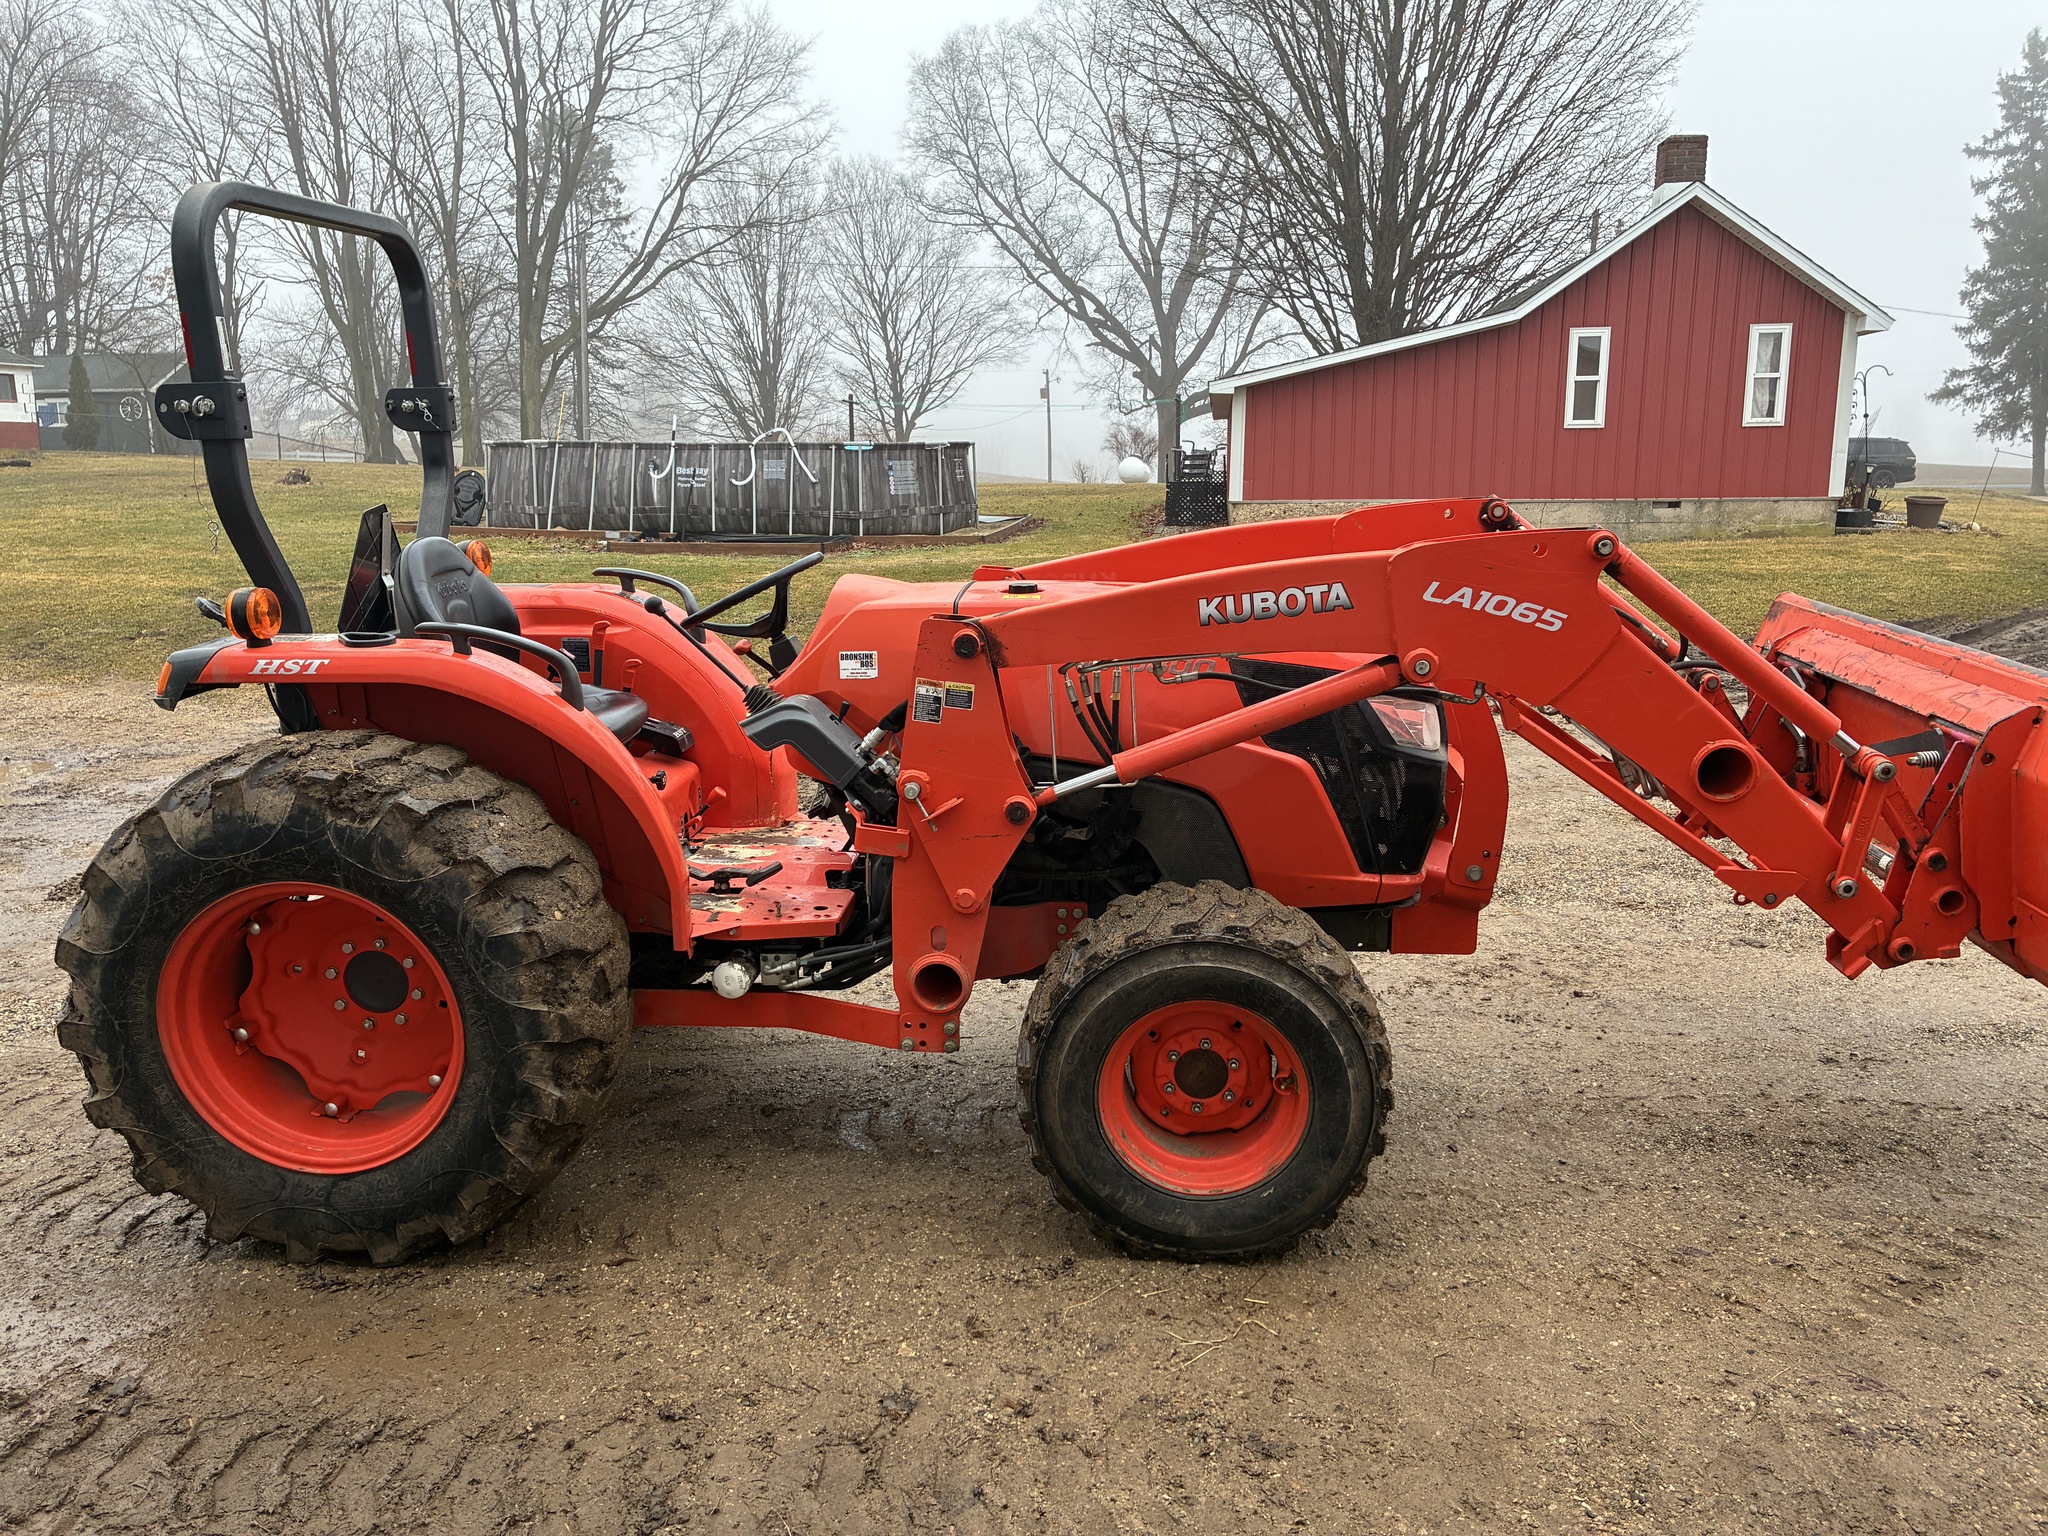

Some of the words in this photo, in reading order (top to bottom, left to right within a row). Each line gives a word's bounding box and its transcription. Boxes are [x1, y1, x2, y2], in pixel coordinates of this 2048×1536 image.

[1198, 582, 1354, 627] KUBOTA
[1421, 581, 1569, 632] LA1065
[840, 652, 874, 661] BRONSINK
[860, 660, 874, 668] BOS
[248, 658, 331, 675] HST
